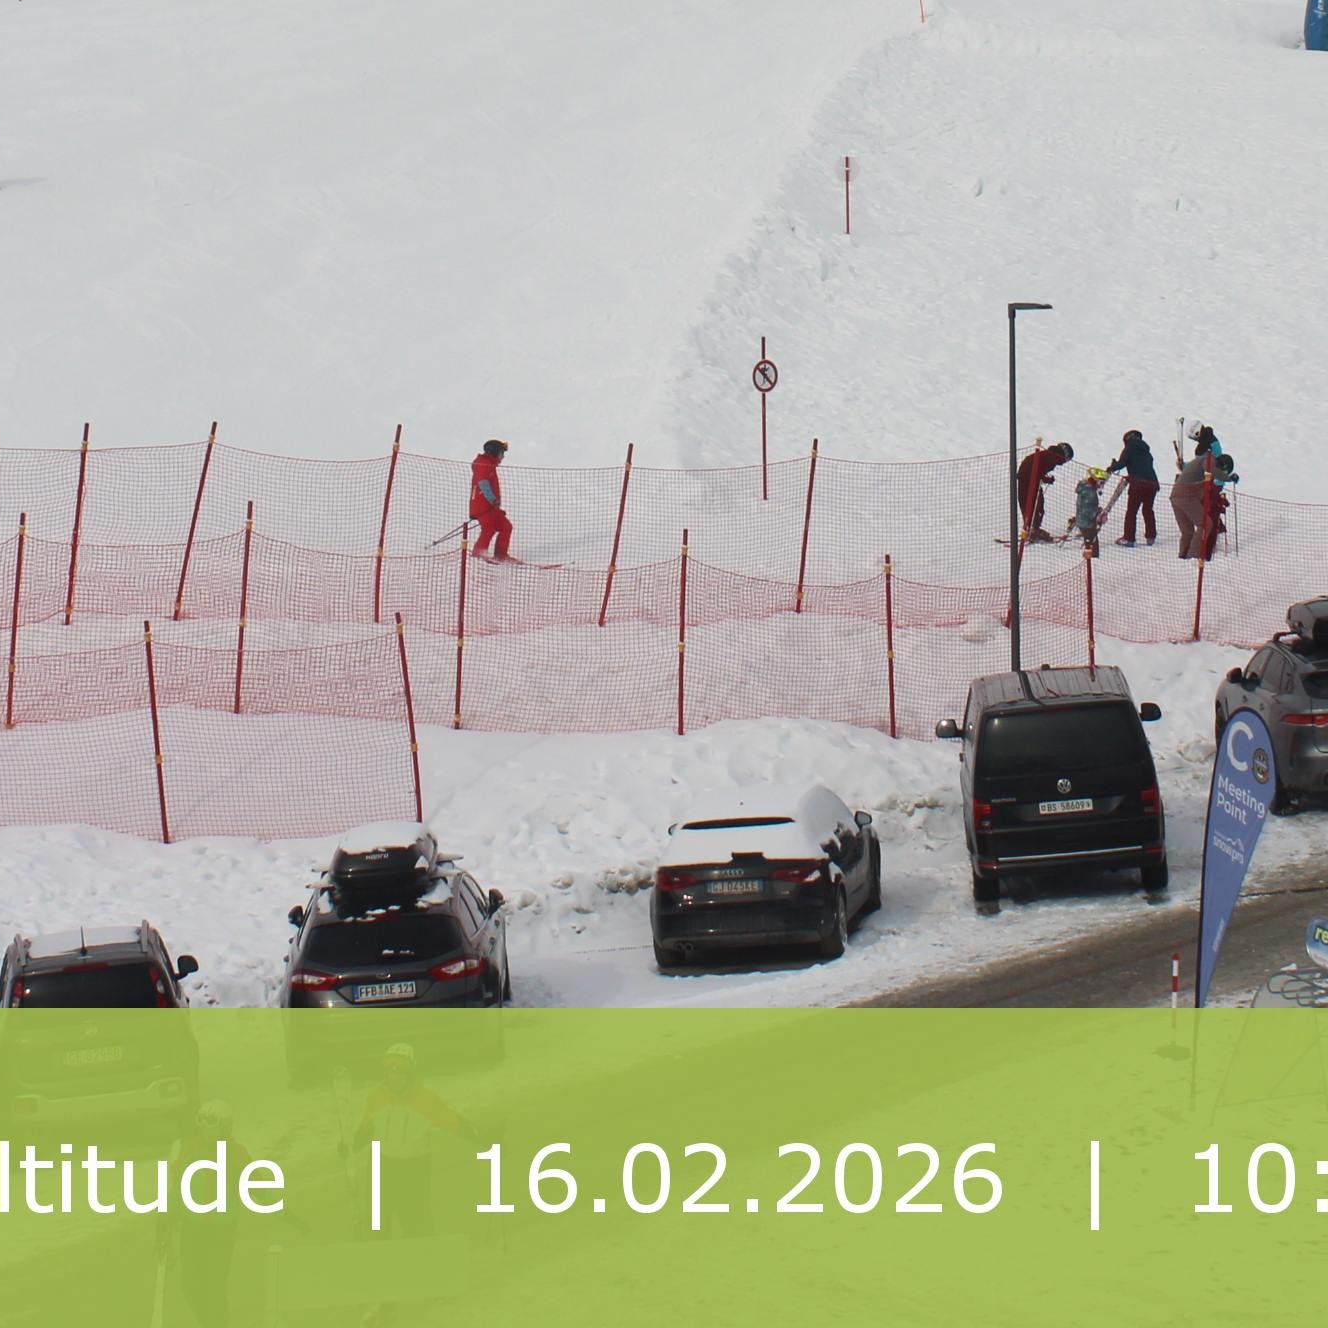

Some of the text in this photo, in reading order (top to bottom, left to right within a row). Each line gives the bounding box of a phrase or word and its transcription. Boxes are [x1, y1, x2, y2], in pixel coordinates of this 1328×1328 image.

[1216, 792, 1247, 825] Point
[1218, 774, 1266, 819] Meeting
[359, 986, 377, 997] FFB
[398, 983, 414, 993] 121
